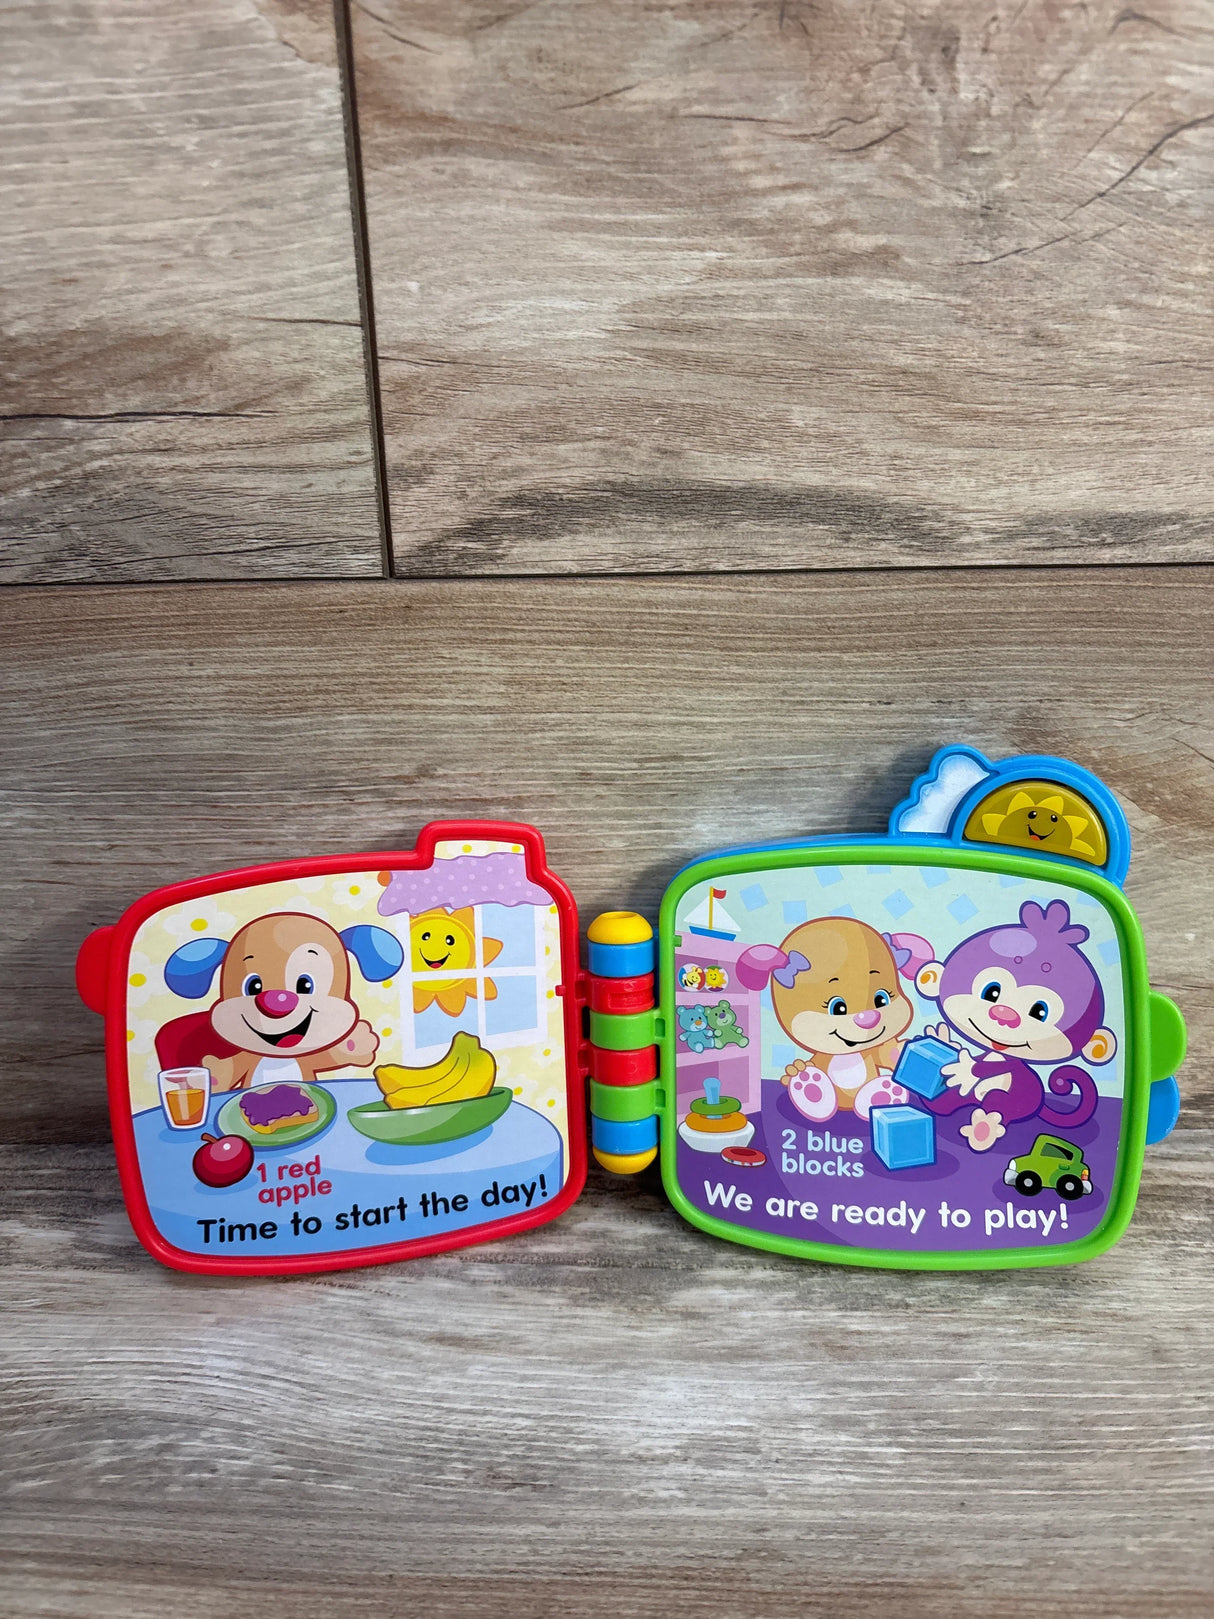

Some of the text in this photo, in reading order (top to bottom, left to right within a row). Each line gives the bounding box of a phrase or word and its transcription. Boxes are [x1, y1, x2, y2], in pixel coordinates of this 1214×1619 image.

[781, 1129, 864, 1155] 2 blue
[256, 1155, 321, 1183] 1 red
[781, 1153, 865, 1178] blocks
[258, 1177, 332, 1207] apple
[197, 1174, 549, 1244] Time to start the day!
[704, 1180, 1069, 1237] We are ready to play!
